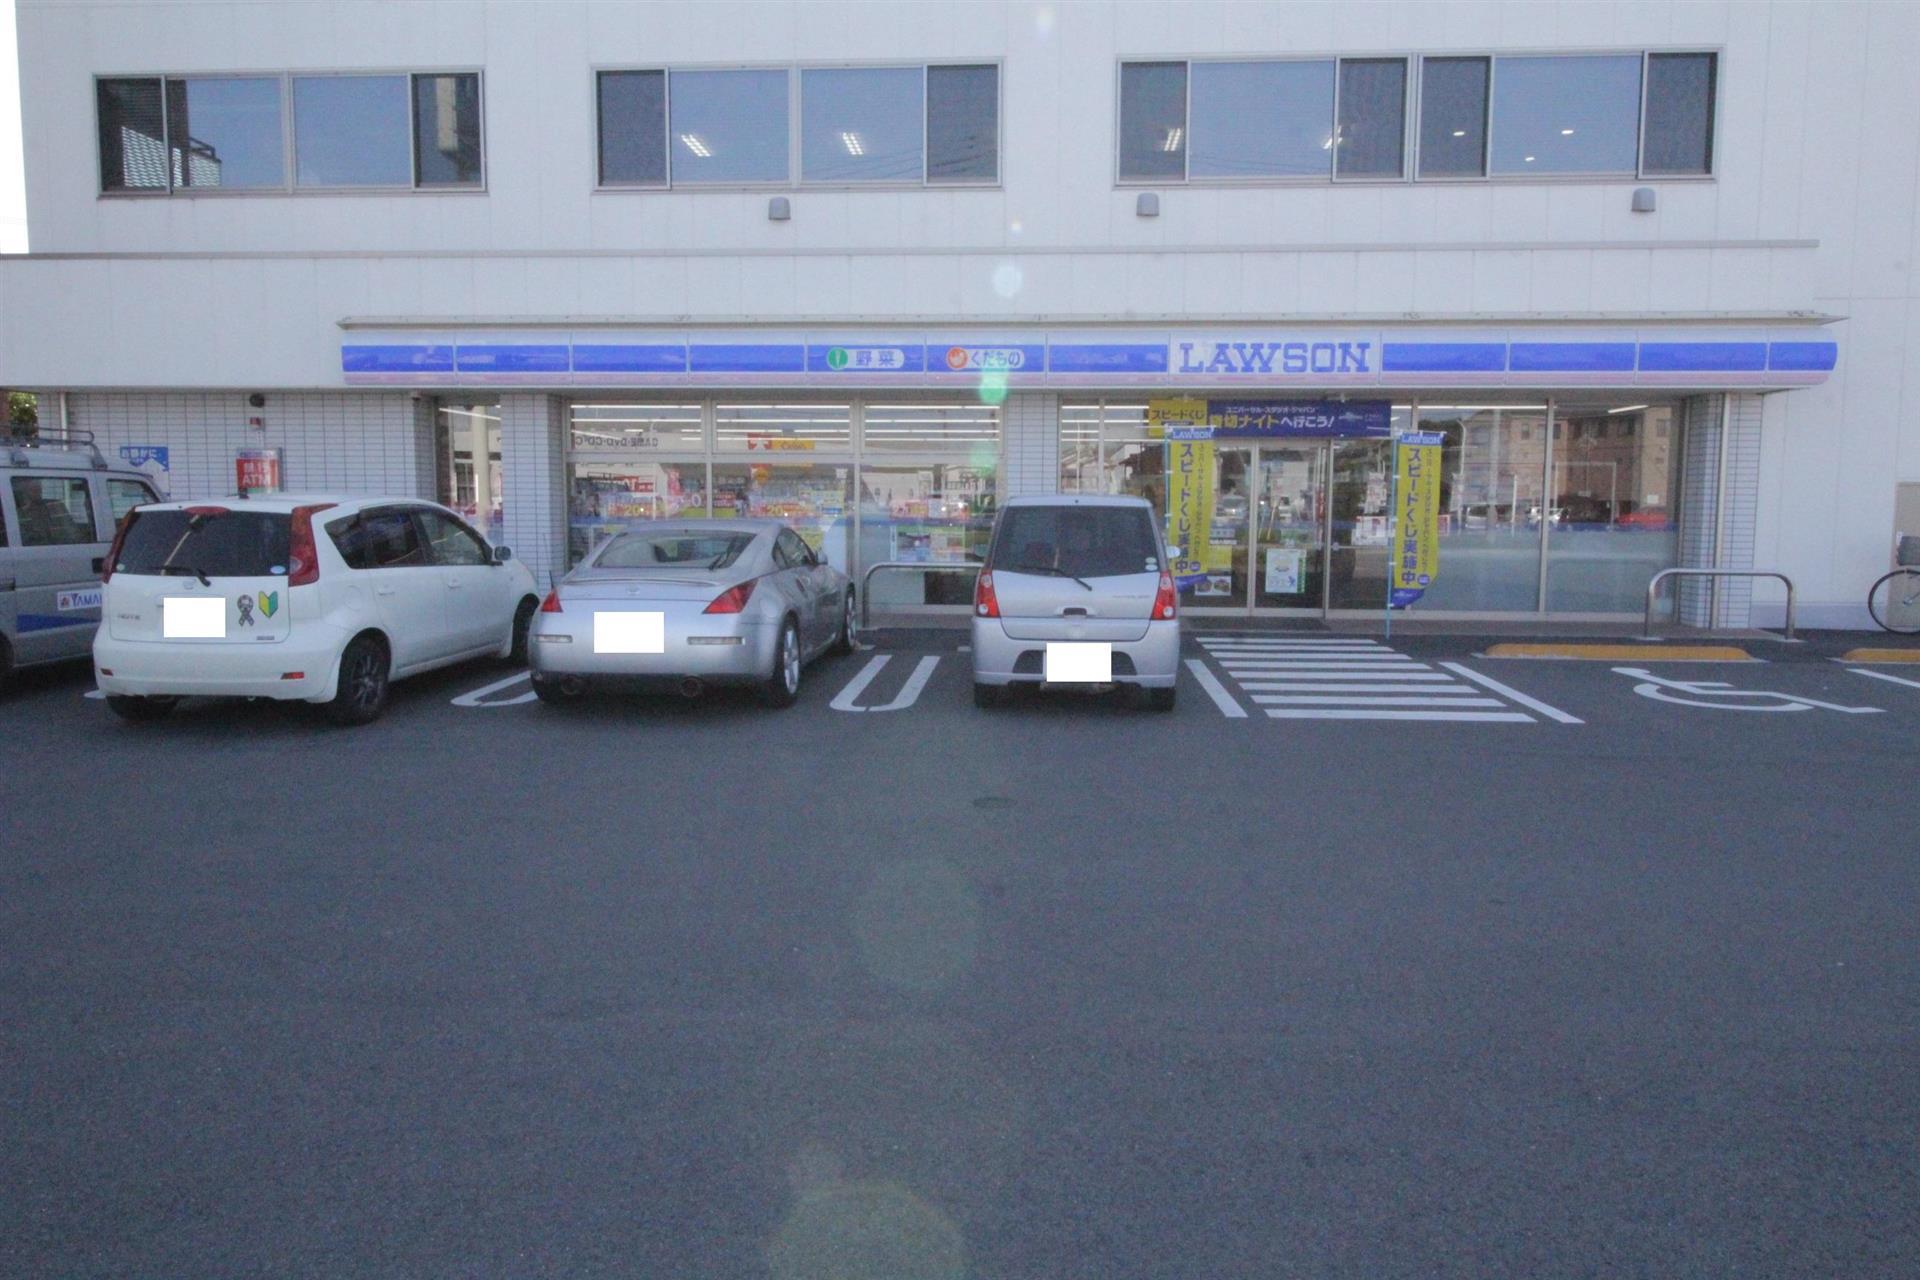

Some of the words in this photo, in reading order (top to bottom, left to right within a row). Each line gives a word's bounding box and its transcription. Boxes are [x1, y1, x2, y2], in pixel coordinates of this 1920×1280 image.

[1178, 342, 1371, 373] LAWSON
[1151, 409, 1204, 421] スピードくじ
[1401, 448, 1422, 585] スピードくじ実施中
